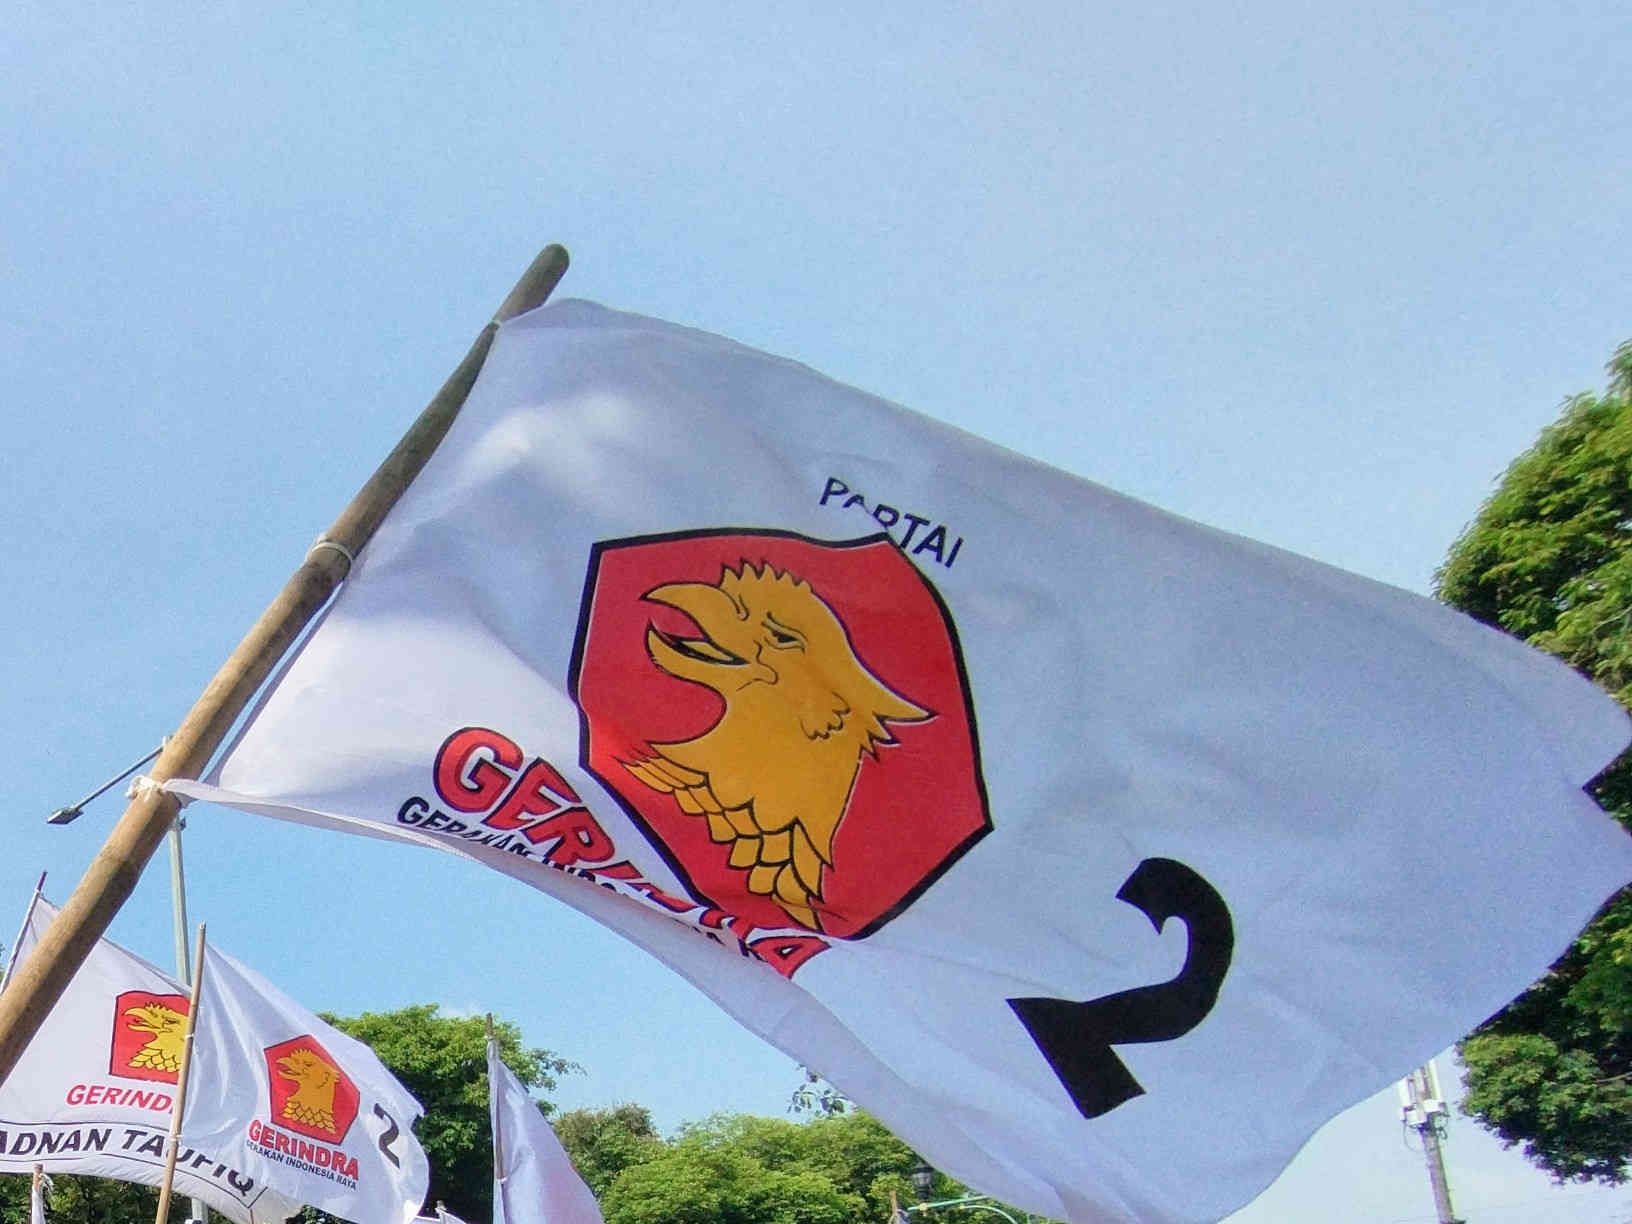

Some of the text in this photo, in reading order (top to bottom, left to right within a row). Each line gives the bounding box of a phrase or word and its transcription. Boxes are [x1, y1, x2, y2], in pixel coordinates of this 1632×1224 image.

[820, 477, 965, 568] PARTAI
[1007, 857, 1234, 1119] 2
[67, 1084, 176, 1115] GERIND
[246, 1139, 357, 1191] GERAKAN INDONESIA RAYA
[248, 1119, 360, 1182] GERINDRA
[373, 1102, 402, 1170] 2
